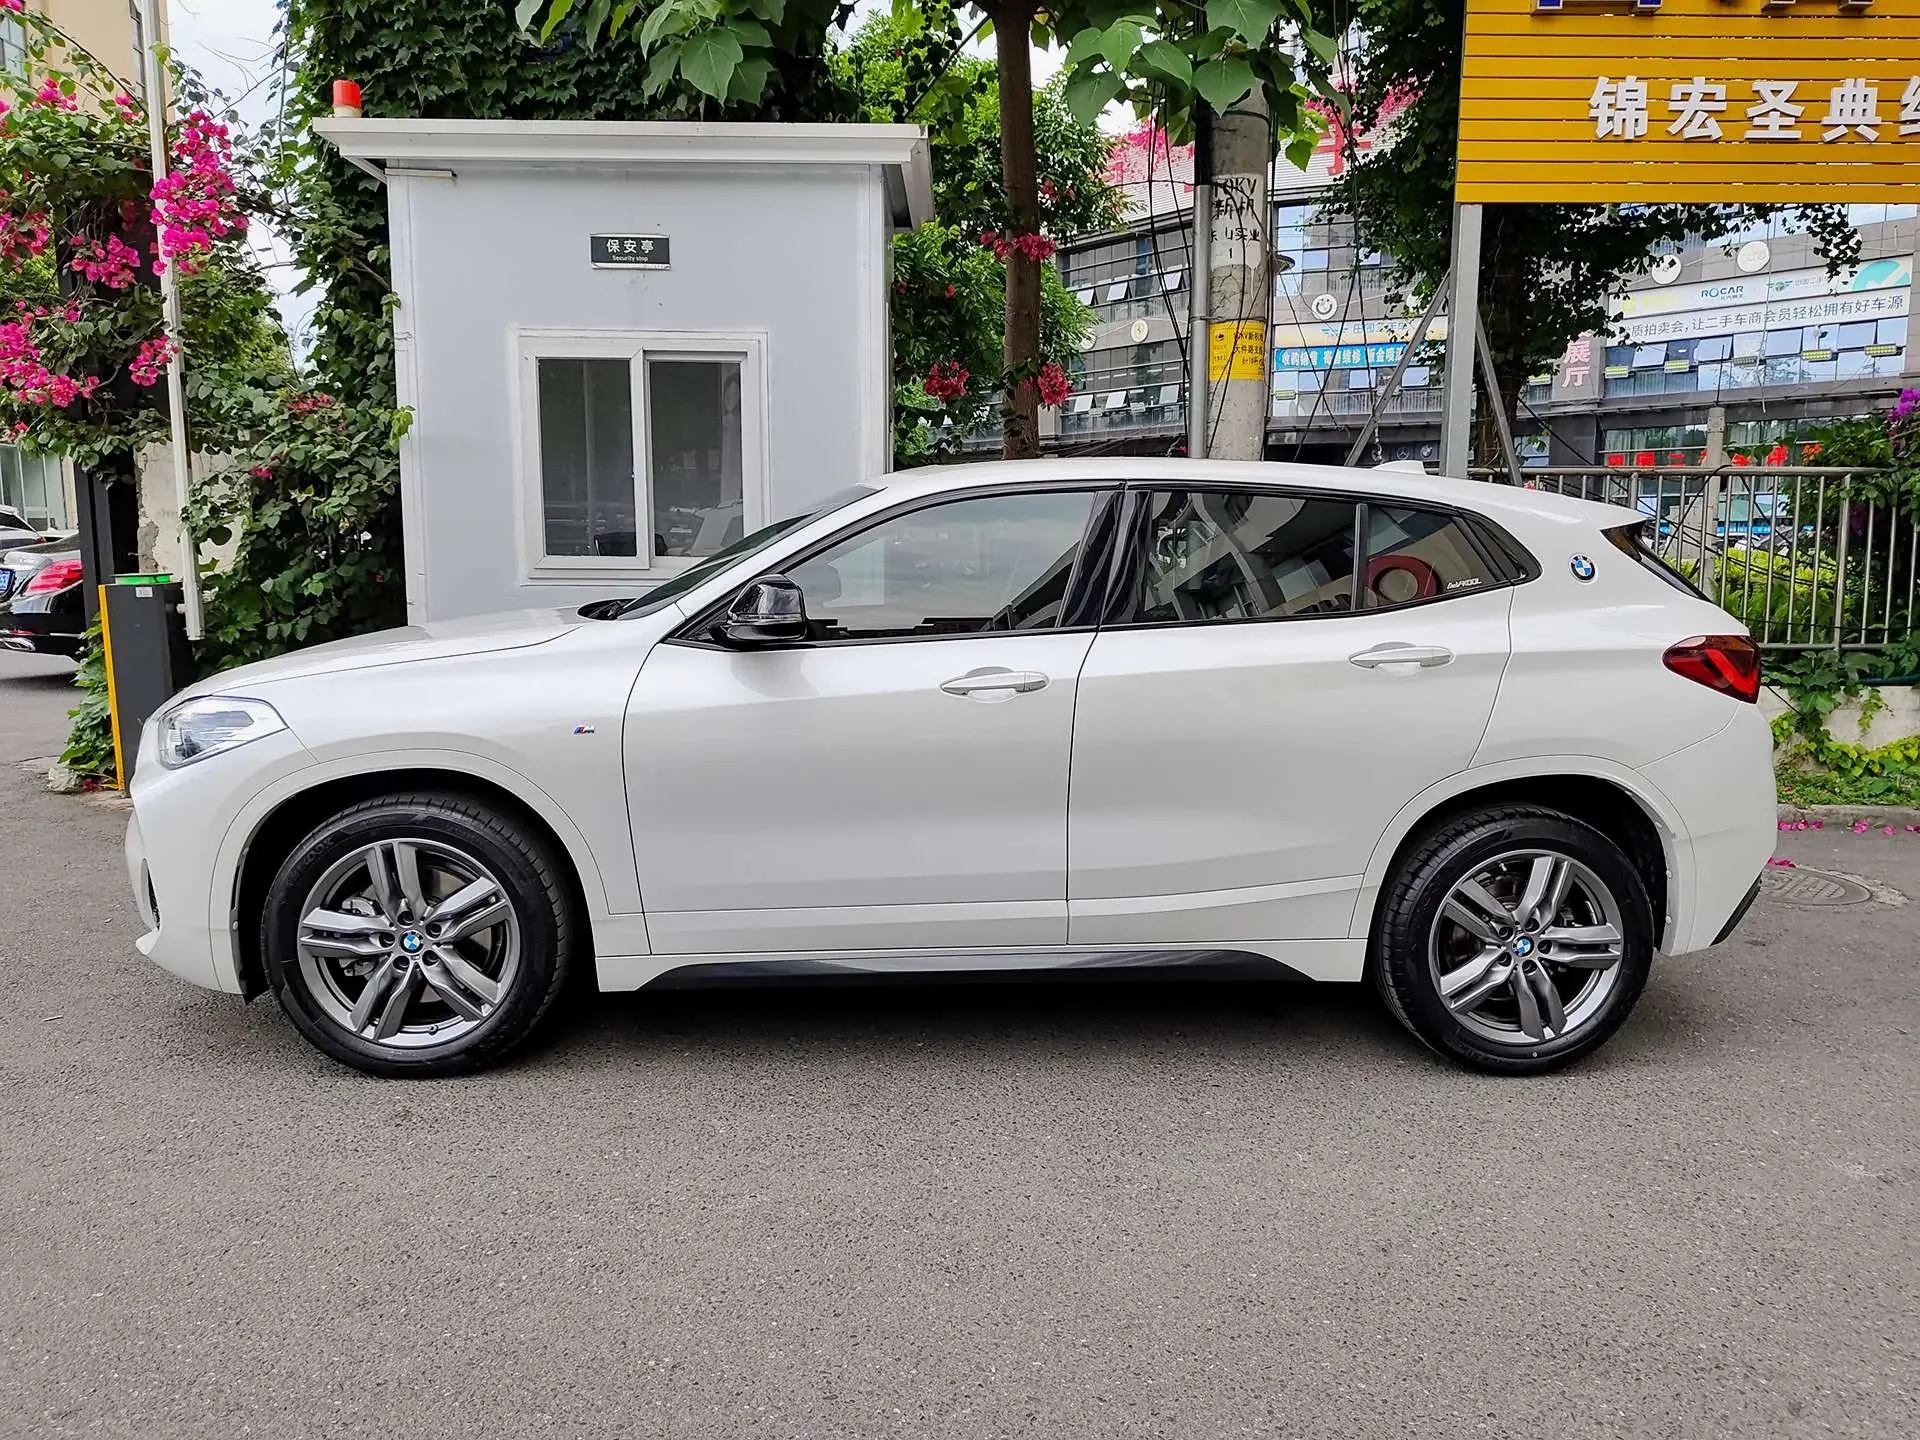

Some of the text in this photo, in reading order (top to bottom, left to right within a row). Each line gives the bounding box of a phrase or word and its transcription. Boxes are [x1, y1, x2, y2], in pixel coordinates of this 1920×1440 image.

[606, 238, 654, 253] 保安亭
[1701, 285, 1744, 298] ROCAR
[1562, 338, 1591, 387] 展厅
